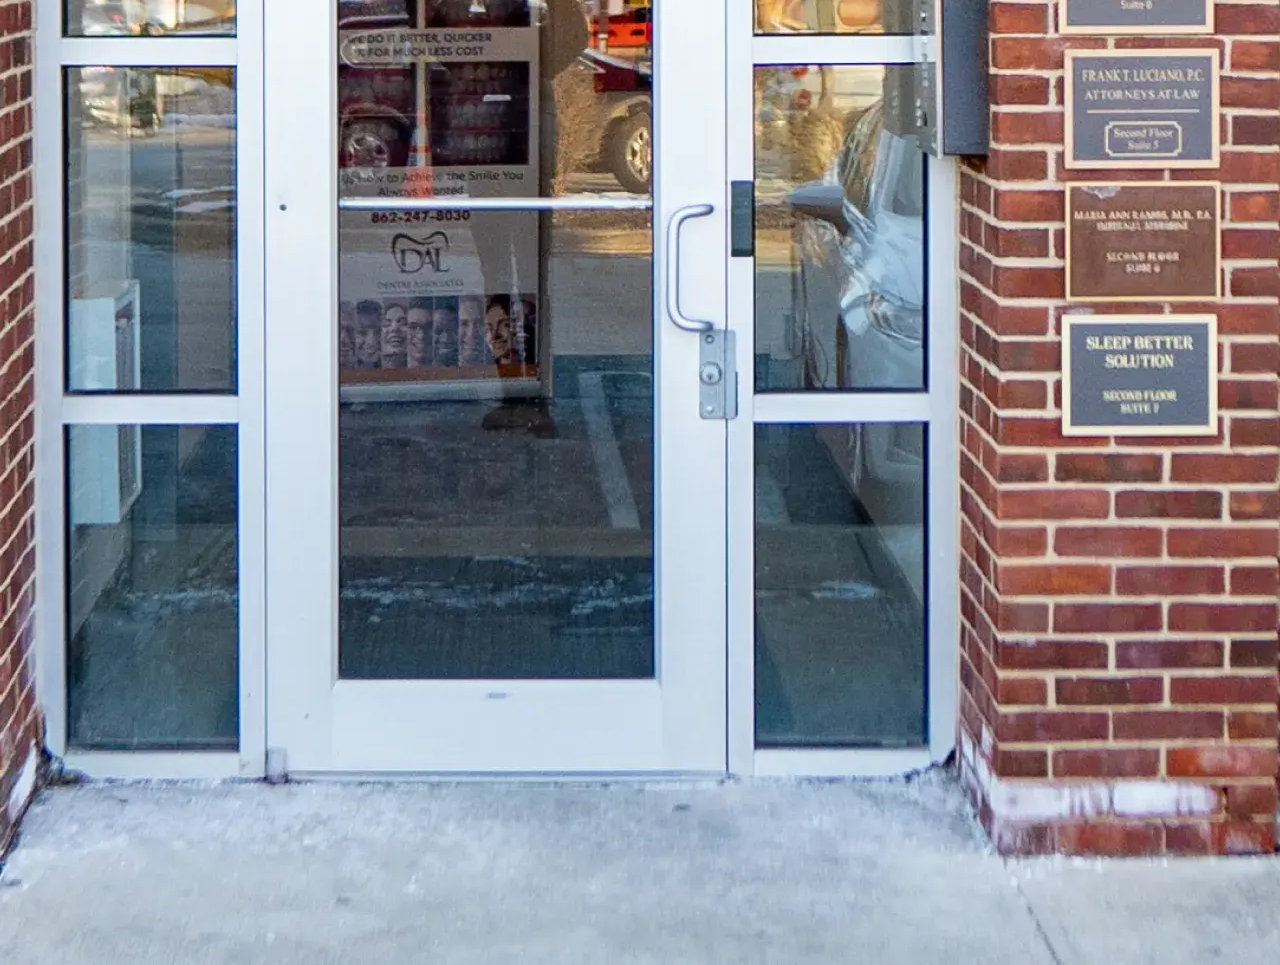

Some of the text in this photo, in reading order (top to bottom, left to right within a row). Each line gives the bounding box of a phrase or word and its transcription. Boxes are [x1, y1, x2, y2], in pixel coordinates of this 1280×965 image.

[366, 34, 384, 44] DO
[386, 34, 396, 44] IT
[443, 33, 492, 44] QUICKER
[428, 47, 453, 57] LESS
[456, 47, 484, 56] COST
[1082, 68, 1205, 82] FRANK T. LUCIANO, P.C.
[1084, 89, 1157, 101] ATTORNEYS
[1113, 128, 1174, 139] Second Floor
[386, 173, 399, 184] to
[446, 171, 466, 181] the
[468, 170, 500, 181] Smile
[502, 170, 524, 181] You
[377, 185, 465, 198] Always Wanted
[371, 211, 470, 224] 862-247-8030
[400, 246, 451, 274] DAL
[1106, 252, 1180, 262] SECOND FLOOR
[1085, 335, 1194, 350] SLEEP BETTER
[1104, 353, 1174, 368] SOLUTION
[1102, 390, 1177, 402] SECOND FLOOR
[1120, 403, 1152, 414] SUITE
